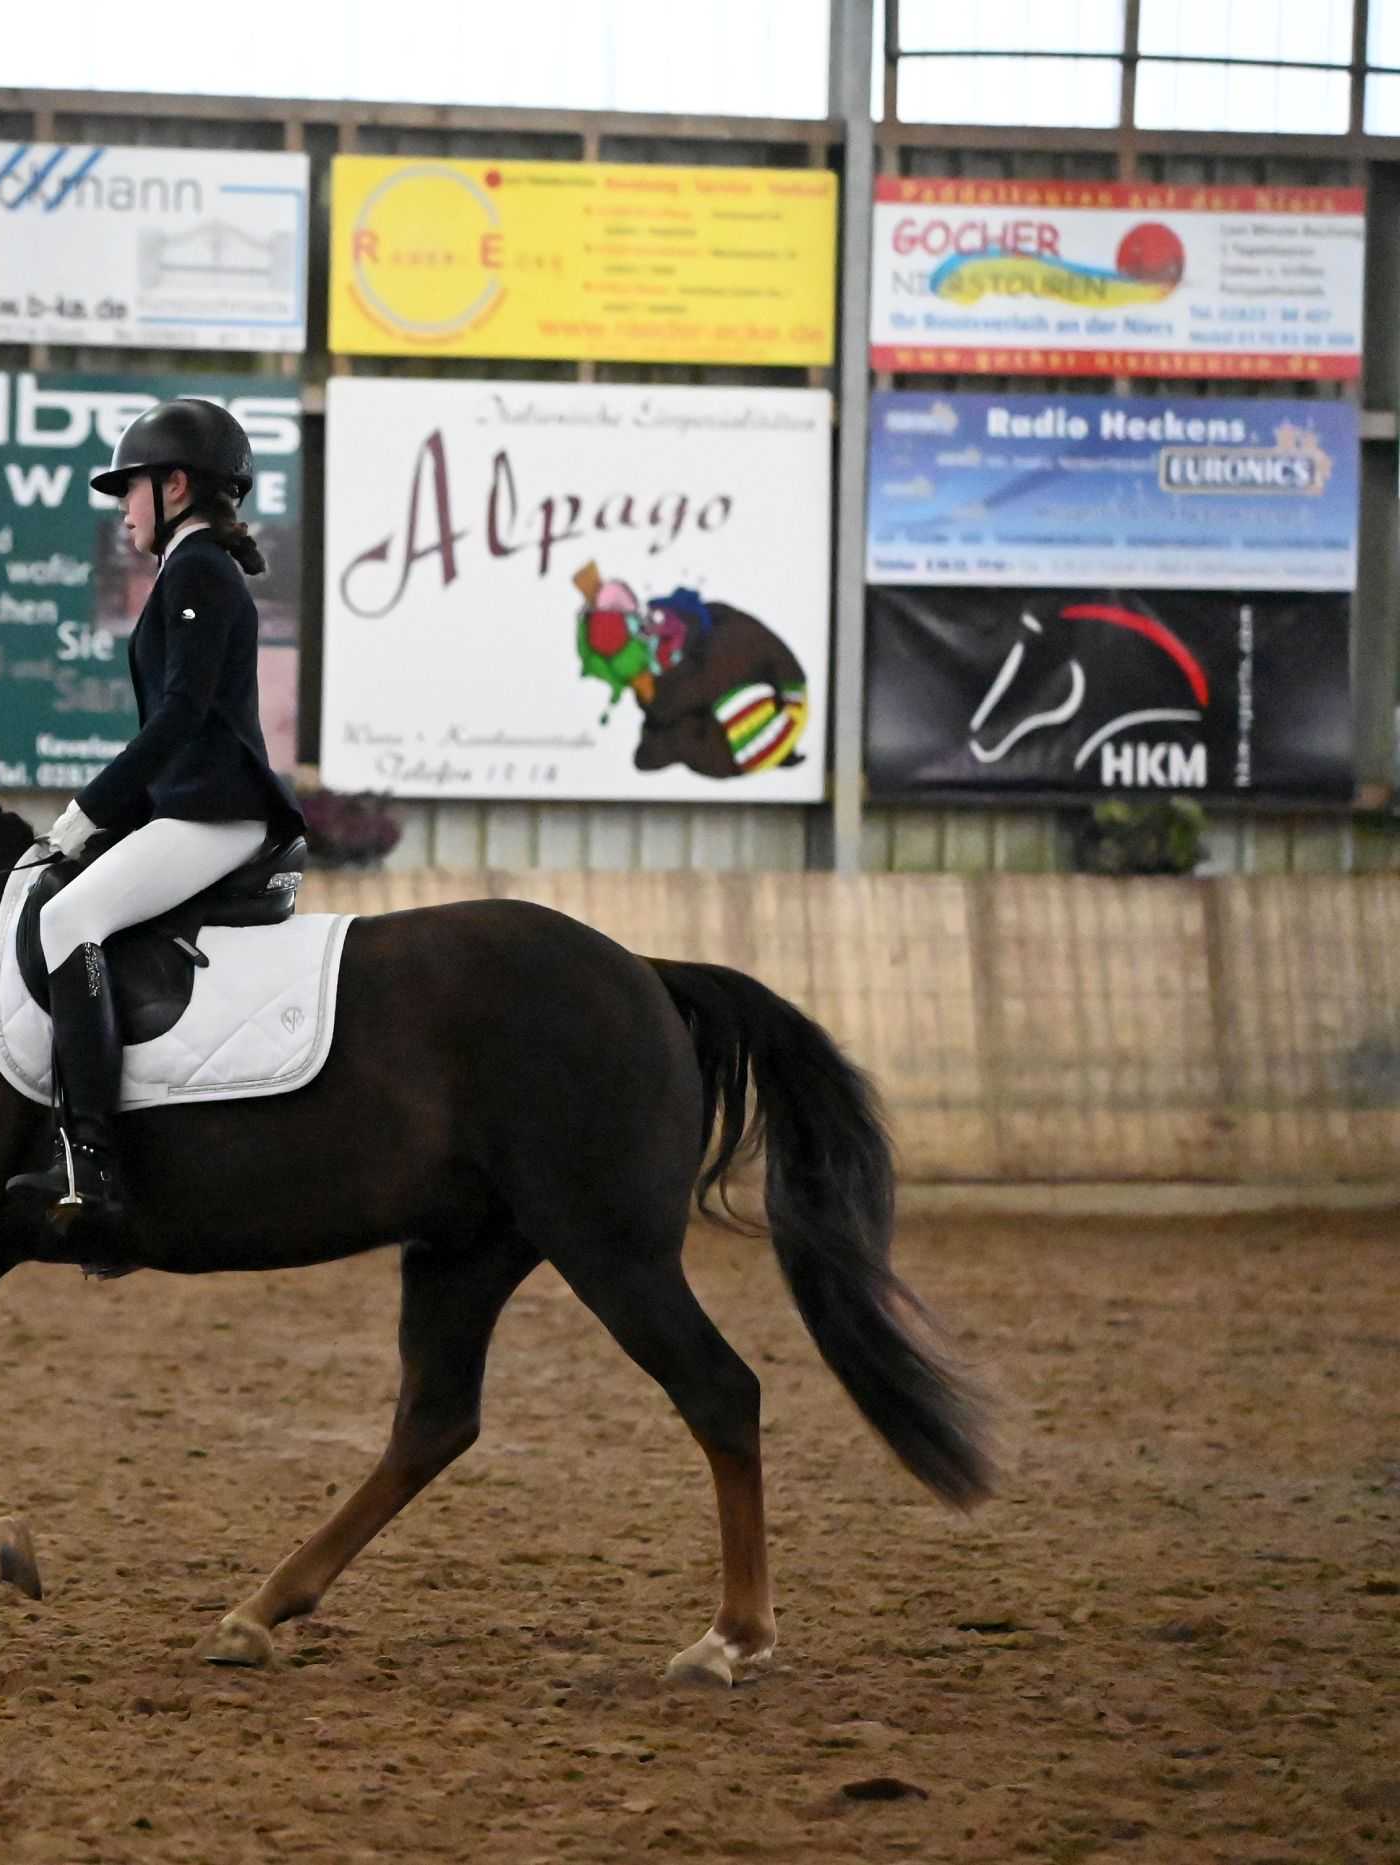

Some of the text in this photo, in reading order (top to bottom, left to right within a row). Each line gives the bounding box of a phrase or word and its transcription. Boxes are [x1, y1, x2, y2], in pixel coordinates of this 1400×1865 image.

[892, 217, 1061, 258] GOCHER
[987, 406, 1089, 440] Radio
[1100, 409, 1245, 443] Heckens
[1168, 456, 1311, 487] EURONICS
[340, 428, 732, 619] Alpago
[57, 620, 115, 662] Sie
[1101, 742, 1208, 788] HKM
